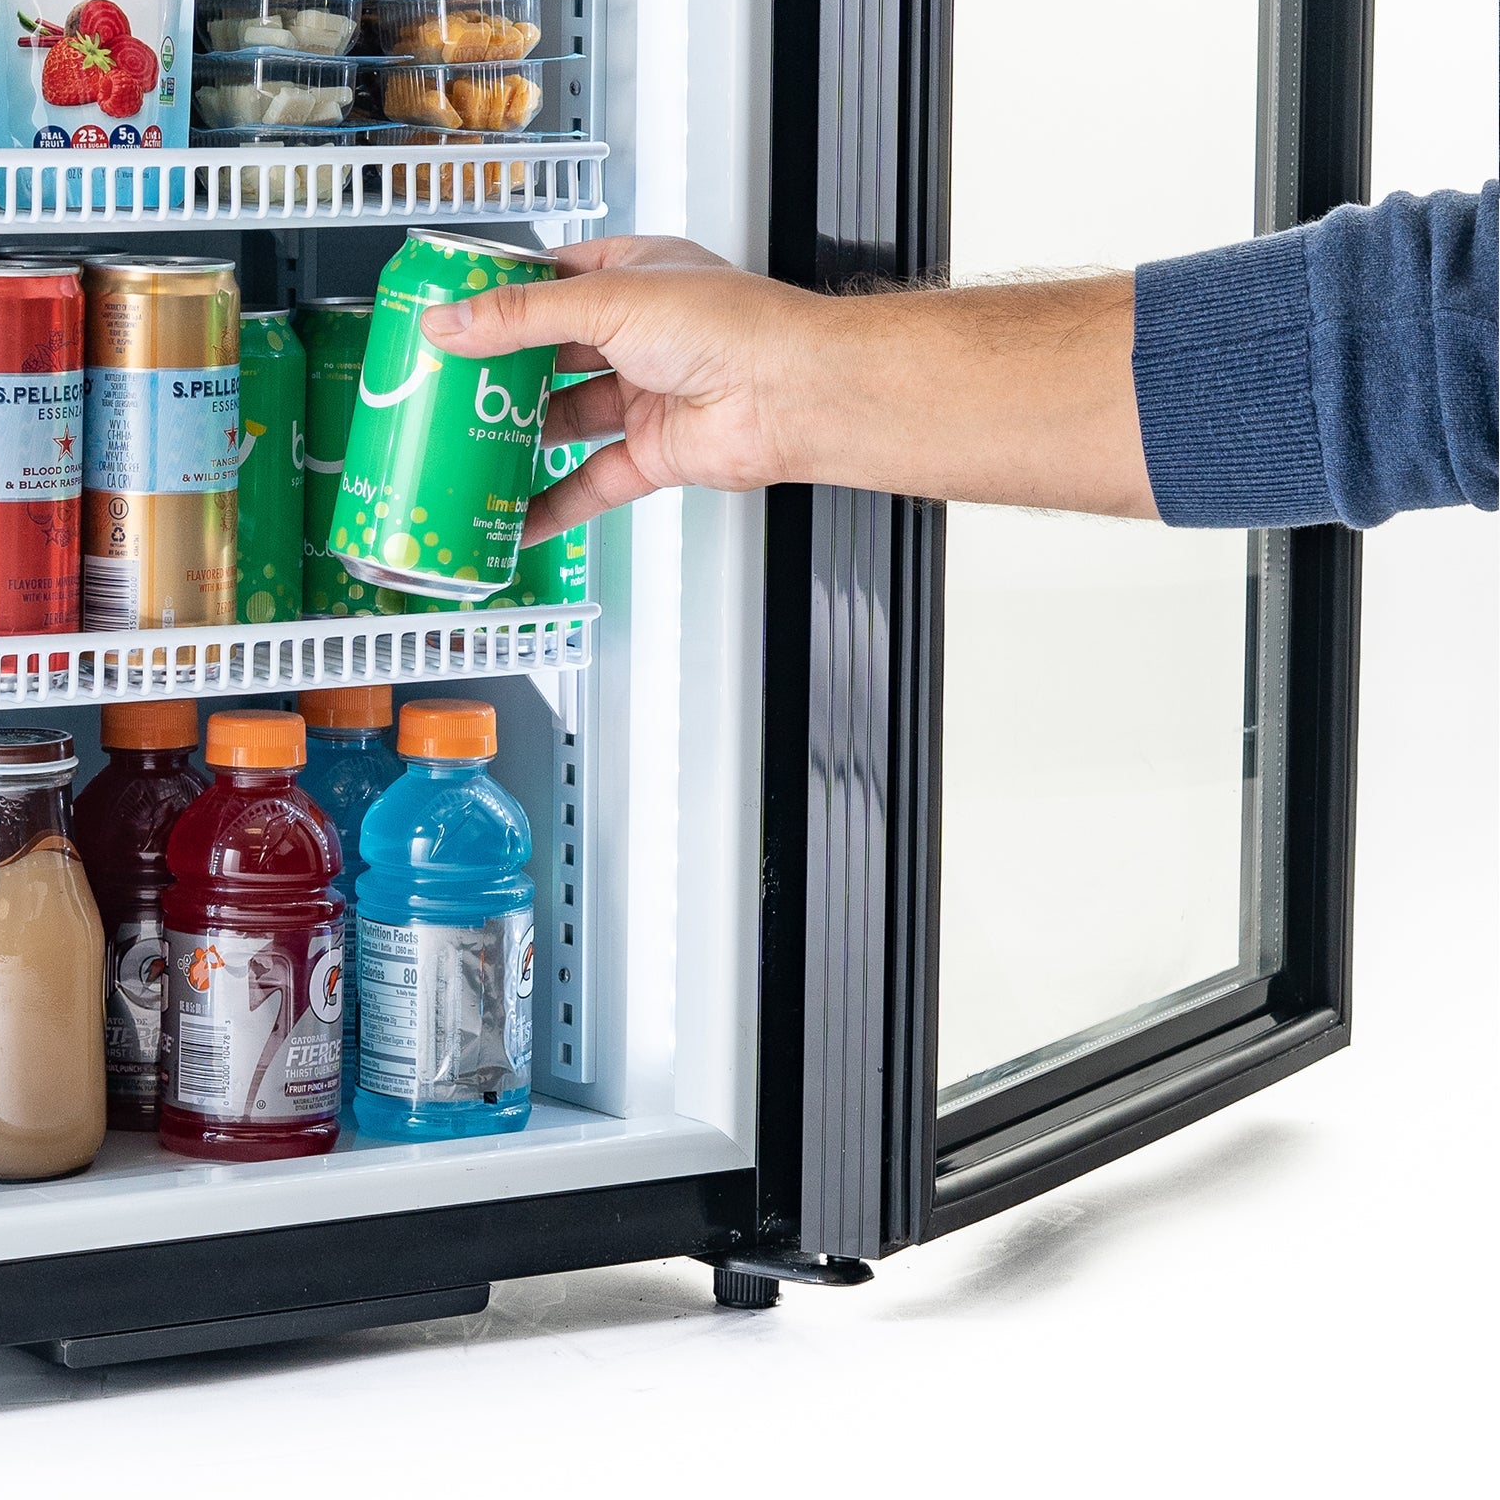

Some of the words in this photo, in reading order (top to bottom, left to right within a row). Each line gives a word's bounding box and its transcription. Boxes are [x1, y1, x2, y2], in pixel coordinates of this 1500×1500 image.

[41, 132, 62, 140] REAL
[119, 128, 135, 144] 5g
[40, 140, 64, 148] FRUIT
[110, 420, 120, 430] WV
[468, 426, 532, 447] sparkling
[23, 467, 62, 476] BLOOD
[182, 474, 190, 482] &
[194, 472, 220, 482] WILD
[5, 481, 14, 490] &
[19, 480, 57, 490] BLACK
[107, 473, 116, 488] CA
[472, 516, 493, 529] lime
[494, 518, 516, 530] flavor
[186, 568, 223, 581] FLAVORED
[8, 578, 52, 590] FLAVORED
[44, 612, 64, 626] ZERO
[362, 922, 392, 940] Nutrition
[394, 929, 418, 944] Facts
[404, 968, 418, 985] 80
[291, 1034, 330, 1045] GATORADE
[222, 1035, 230, 1060] 10478
[286, 1038, 342, 1067] FIERCE
[222, 1064, 230, 1090] 52000
[285, 1068, 312, 1078] THIRST
[290, 1084, 306, 1094] FRUIT
[308, 1082, 324, 1092] PUNCH
